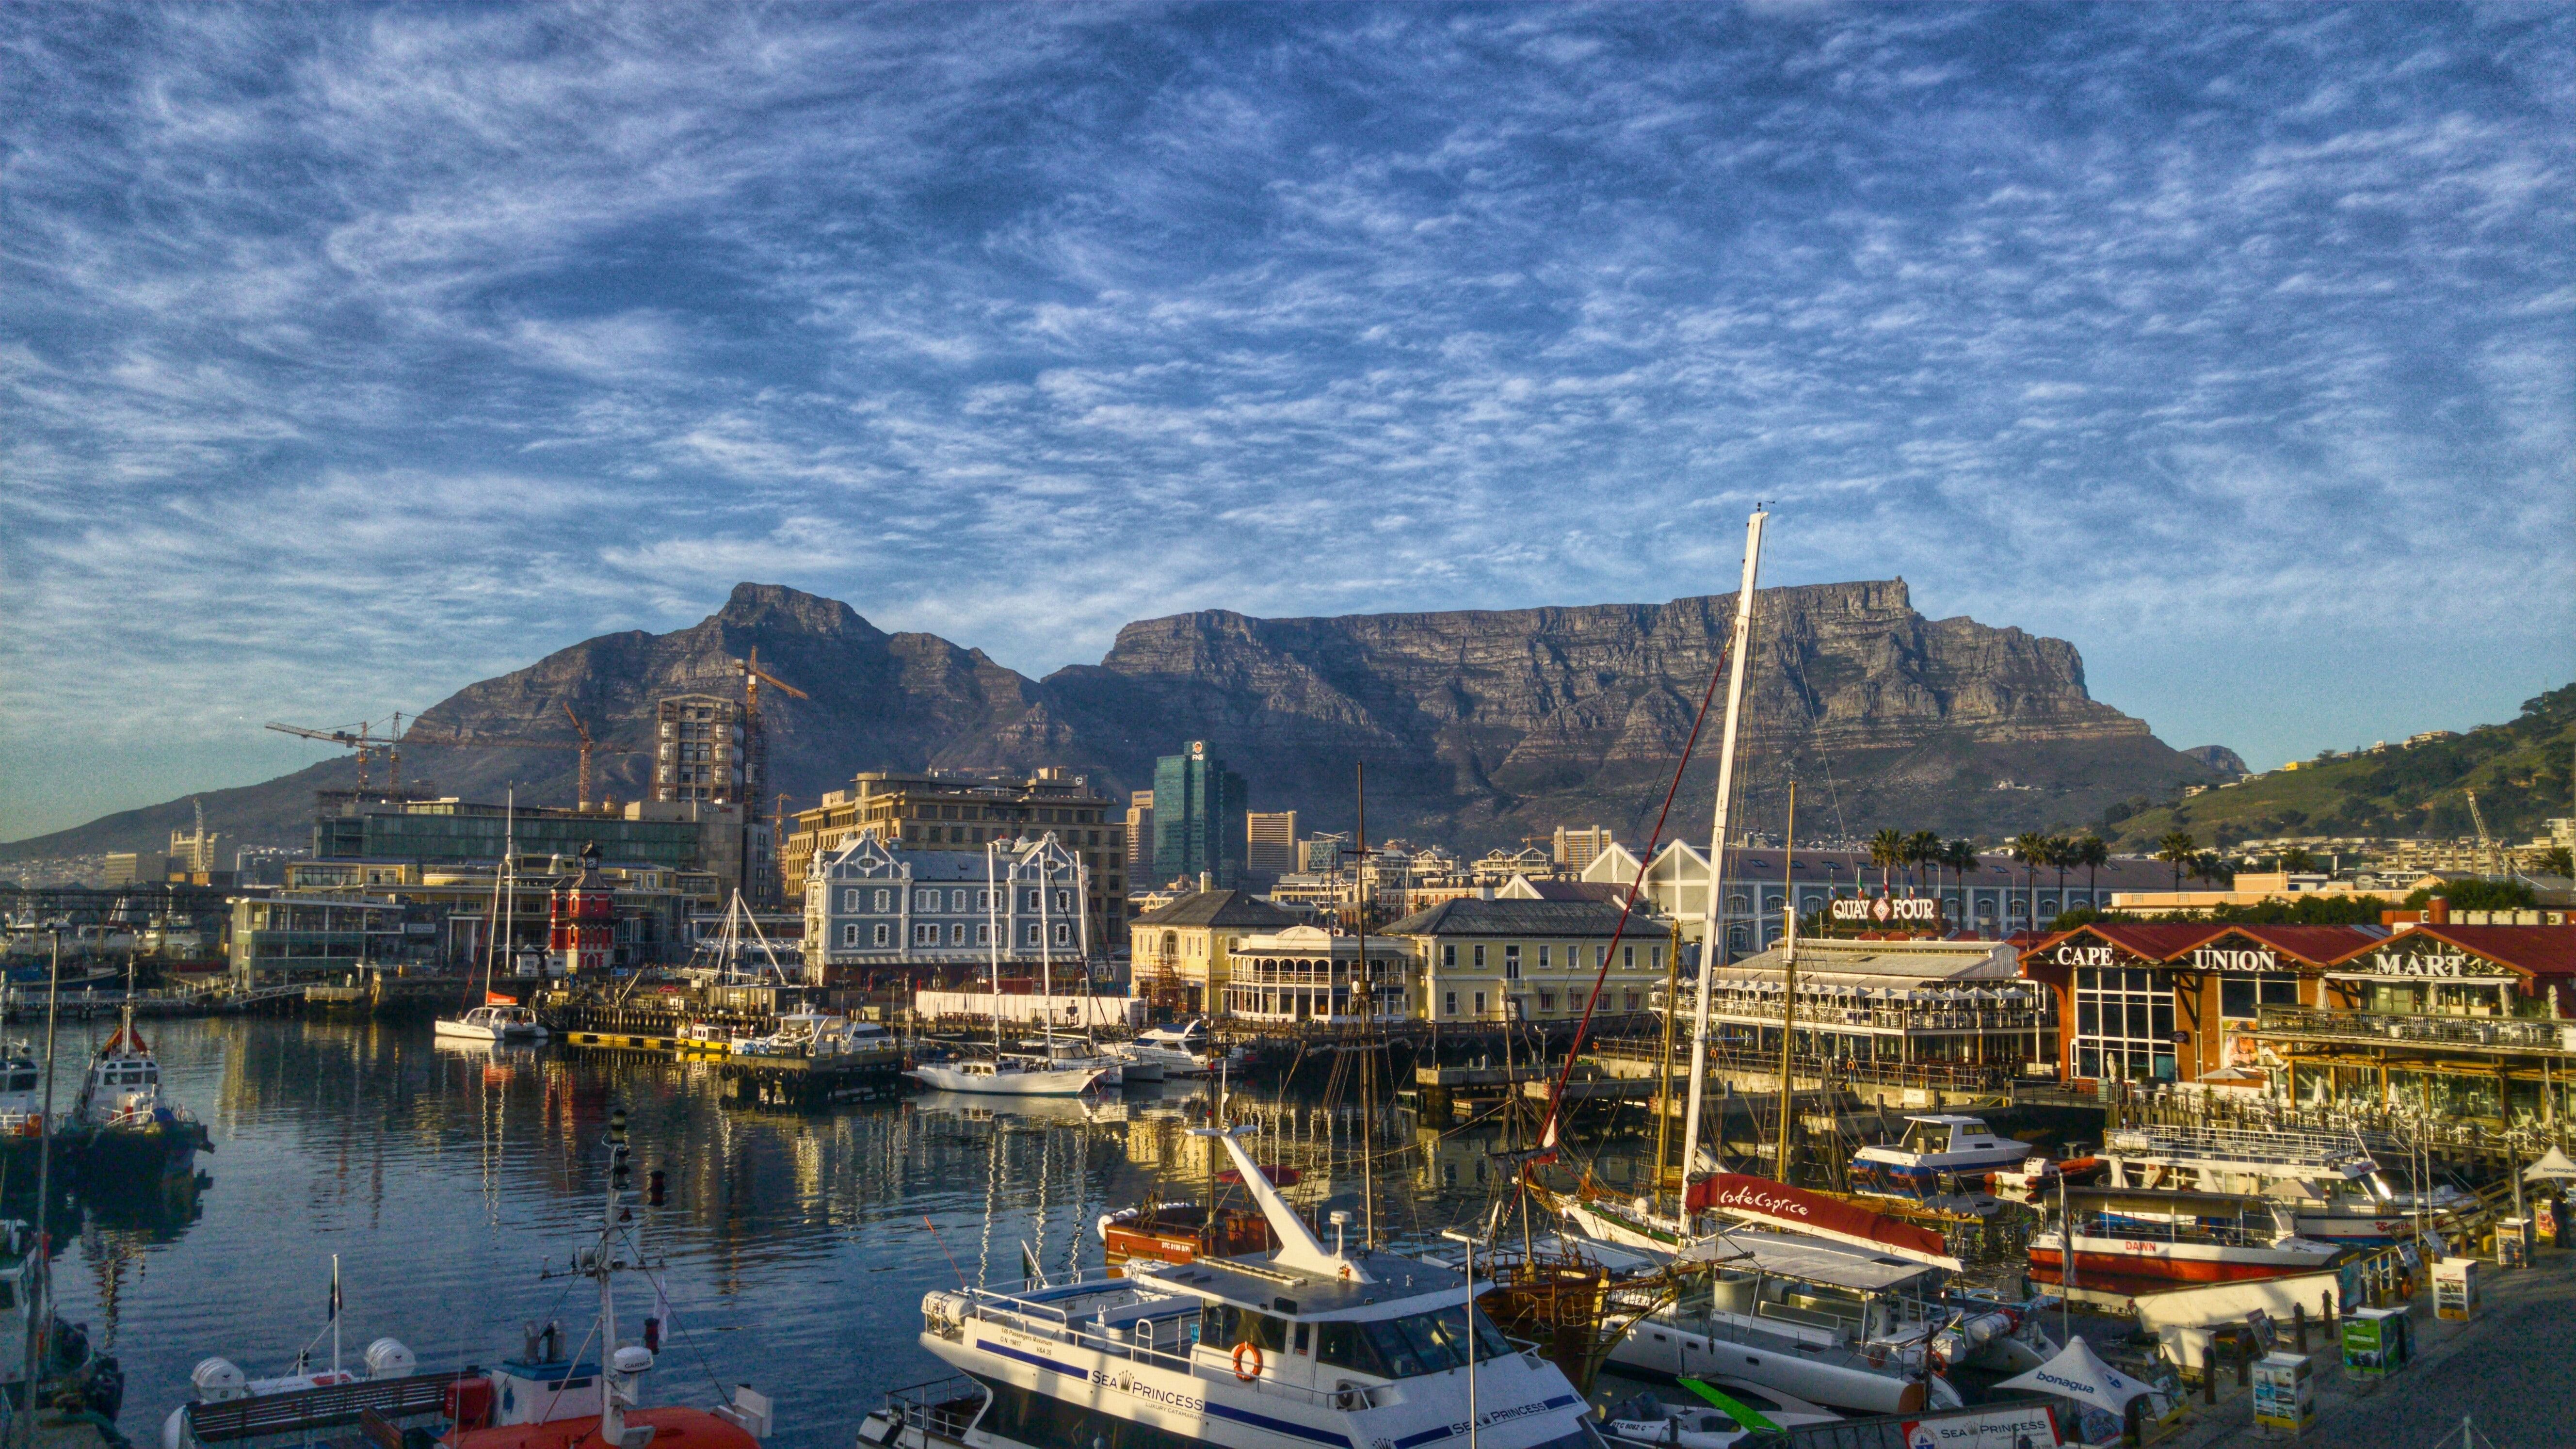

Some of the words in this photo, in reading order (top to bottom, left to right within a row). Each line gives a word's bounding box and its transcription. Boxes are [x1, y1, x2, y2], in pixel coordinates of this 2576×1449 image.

[1833, 900, 1870, 919] QUAY
[1892, 899, 1934, 919] FOUR
[2057, 947, 2113, 966] CAPE
[2193, 950, 2276, 971] UNION
[2374, 953, 2465, 977] MART
[2125, 1241, 2156, 1252] DAWN
[1009, 1329, 1032, 1341] Passengers
[1033, 1336, 1053, 1346] Maximum
[1092, 1370, 1117, 1388] SEA
[1132, 1381, 1203, 1411] PRINCESS
[2036, 1371, 2095, 1394] bonaqua
[1145, 1401, 1166, 1412] LUXURY
[1168, 1408, 1202, 1421] CATAMARAN
[1490, 1403, 1546, 1422] PRINCESS
[1941, 1429, 1967, 1439] SEA
[1980, 1420, 2046, 1434] PRINCESS
